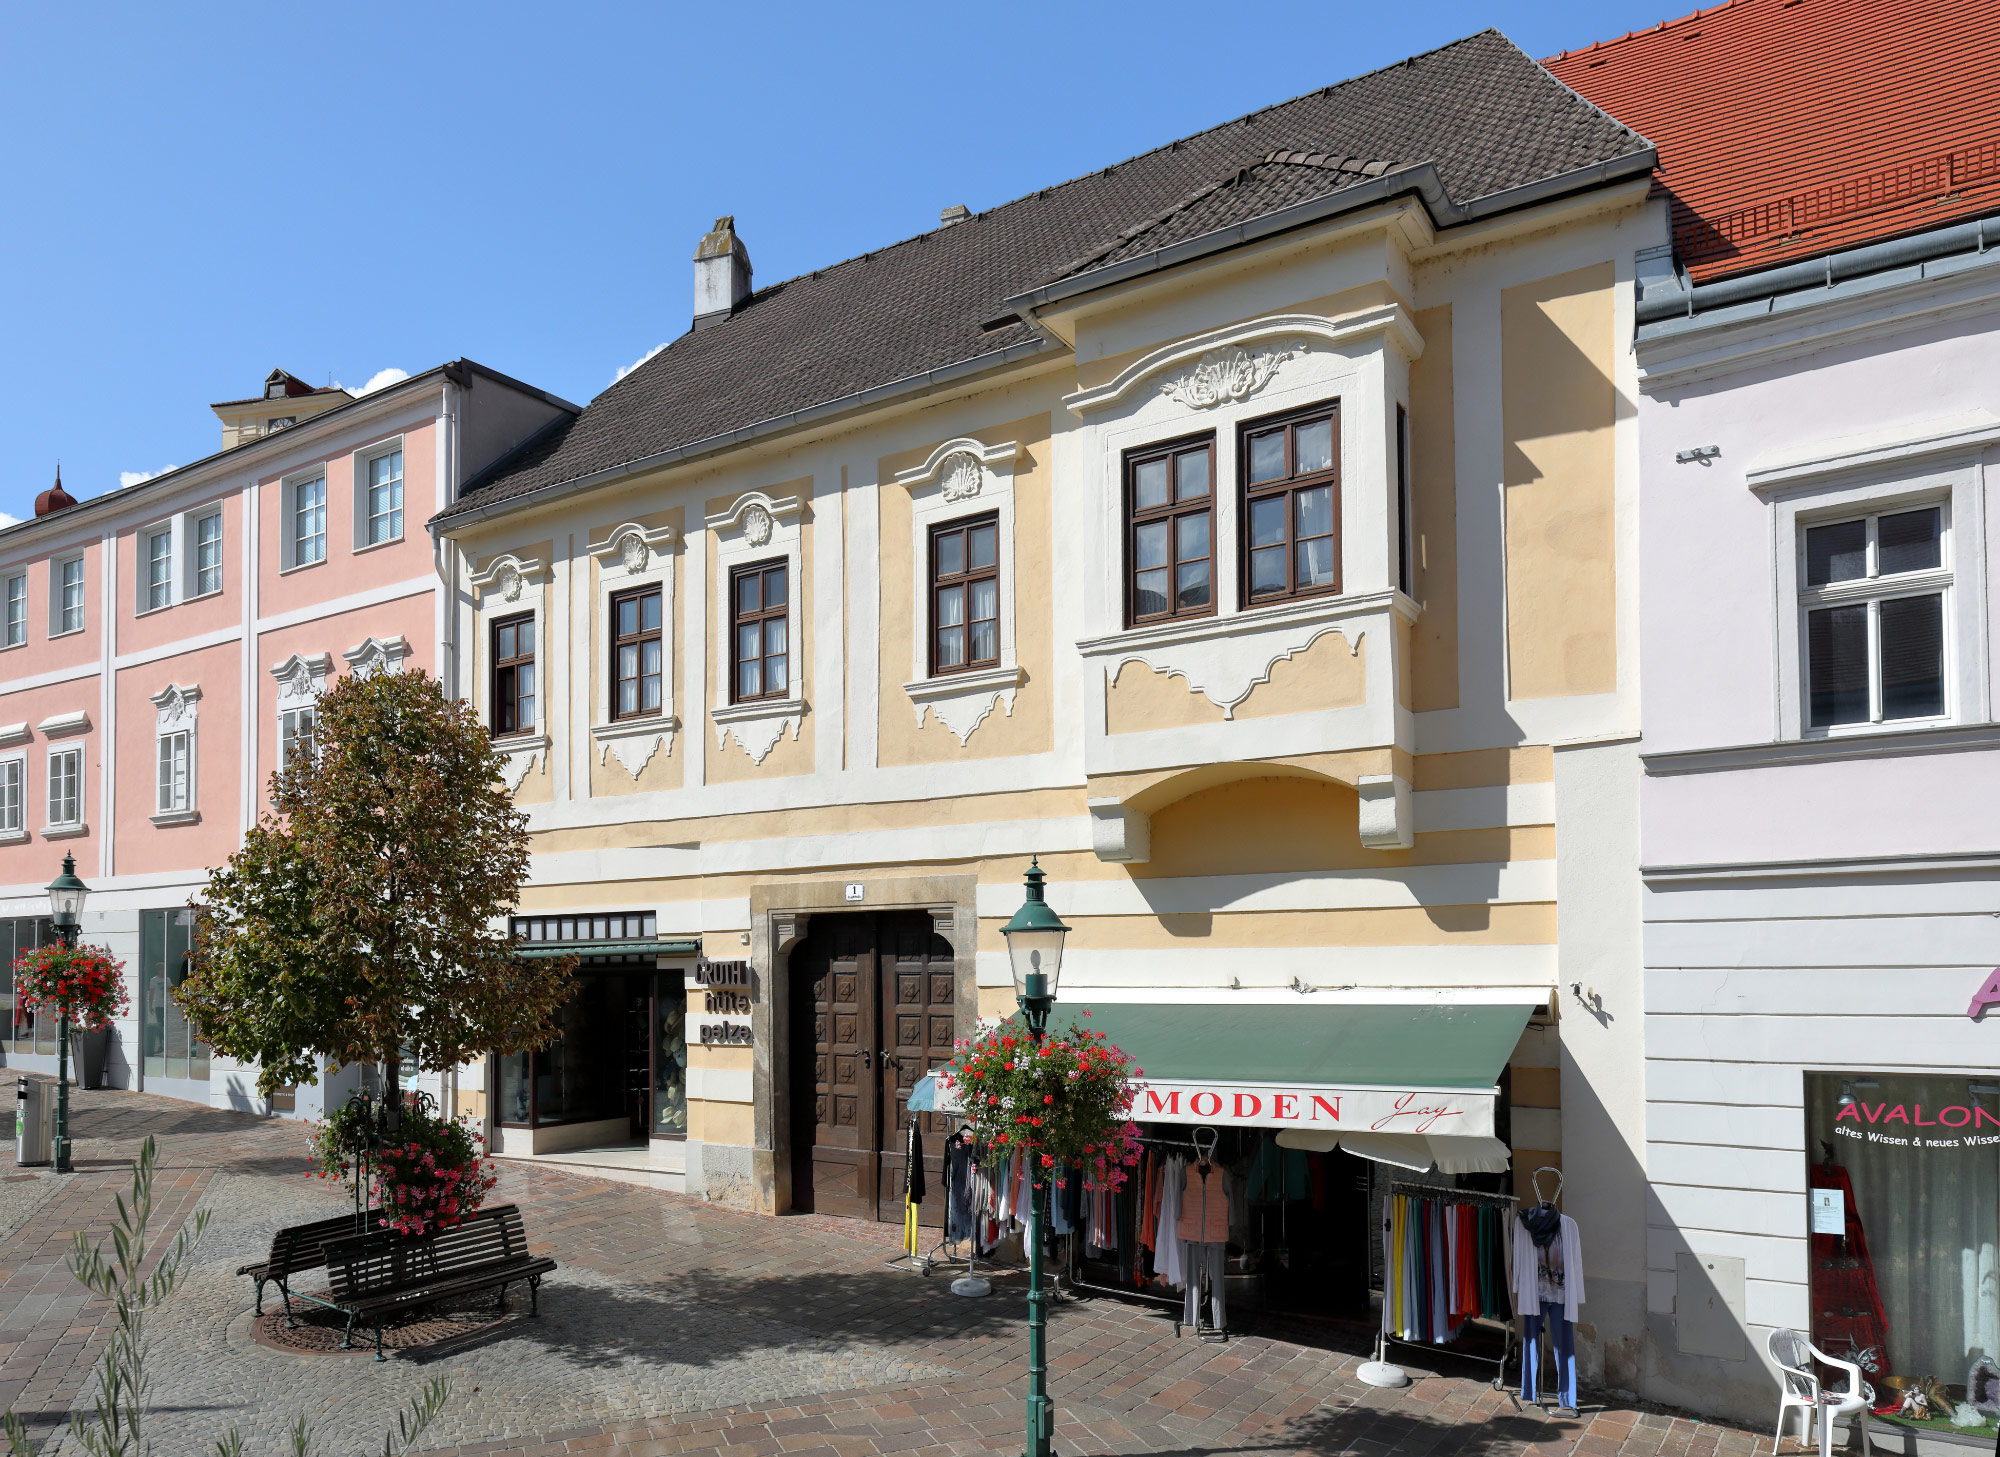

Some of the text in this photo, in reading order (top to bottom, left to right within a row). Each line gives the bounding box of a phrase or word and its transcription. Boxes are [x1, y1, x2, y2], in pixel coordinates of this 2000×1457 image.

[705, 991, 749, 1012] hüte
[700, 1021, 752, 1043] pelze
[1143, 1090, 1464, 1132] MODEN Jay
[1835, 1126, 2000, 1147] altes Wissen & neues Wisse
